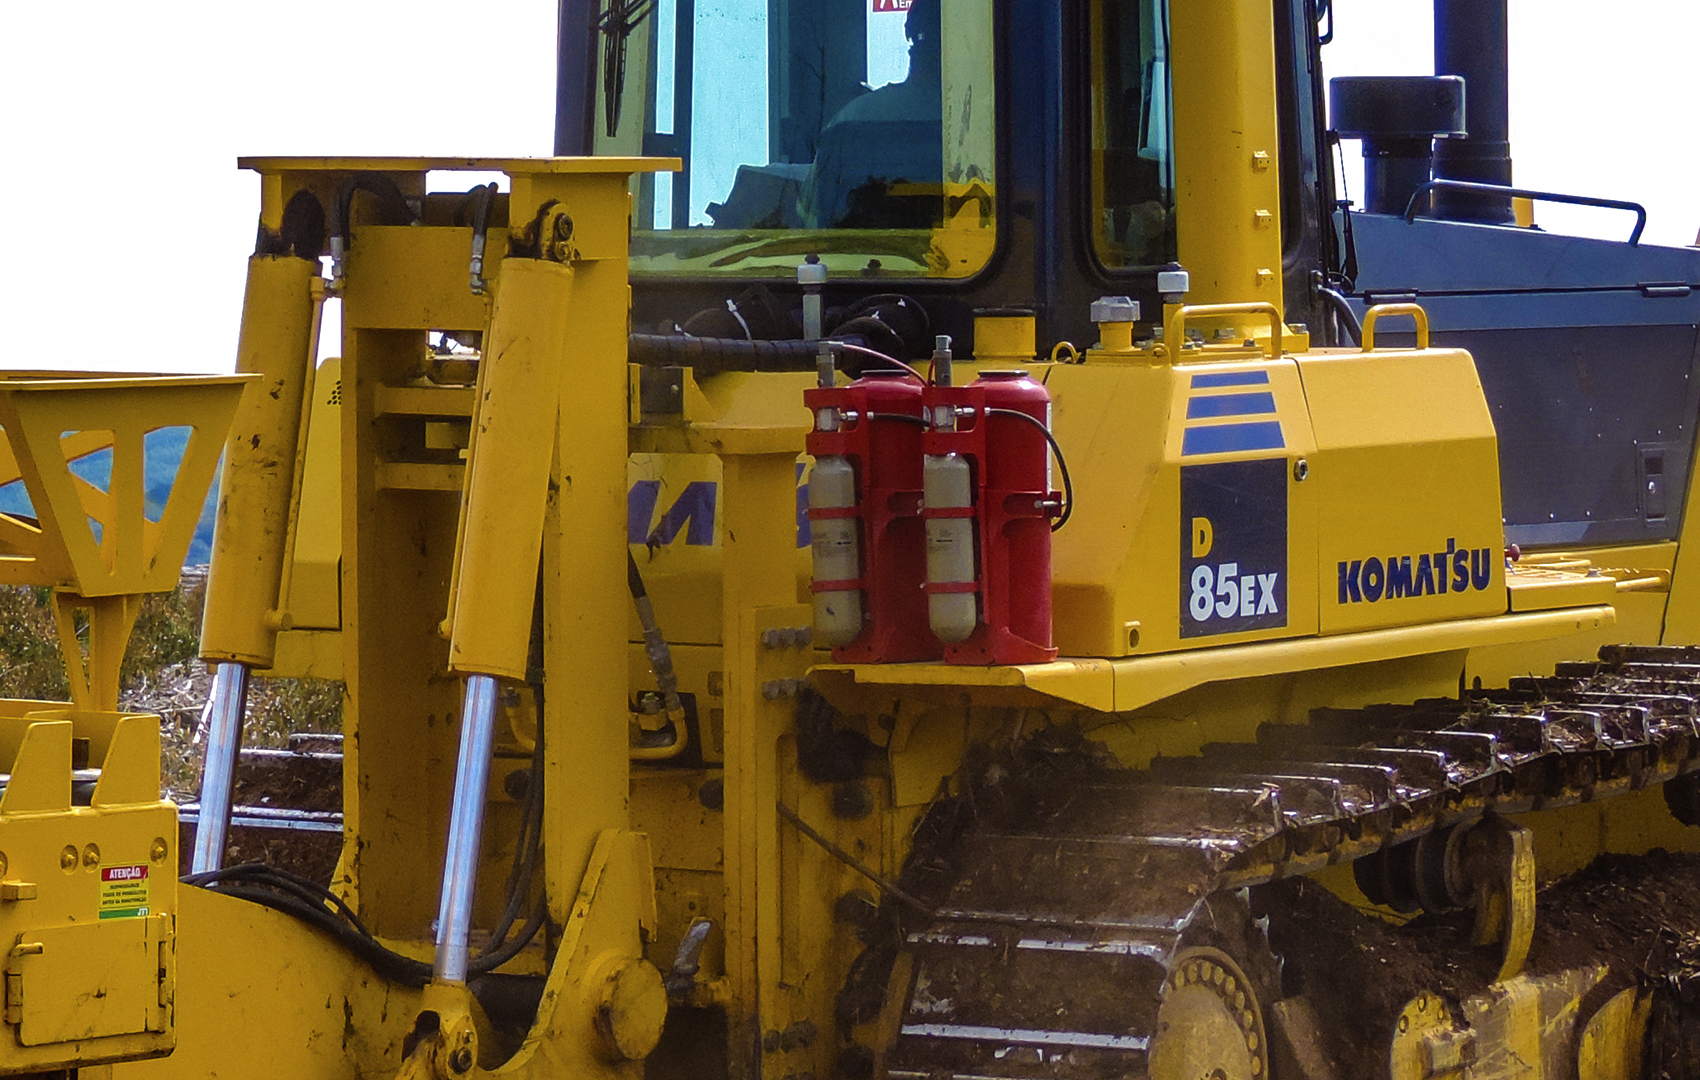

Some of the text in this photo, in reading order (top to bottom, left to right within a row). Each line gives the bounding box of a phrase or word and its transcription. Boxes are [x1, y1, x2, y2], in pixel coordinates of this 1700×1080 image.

[1192, 517, 1213, 558] D
[1190, 563, 1278, 621] 85EX
[1338, 538, 1490, 604] KOMATSU
[109, 866, 141, 879] ATENÇÃO
